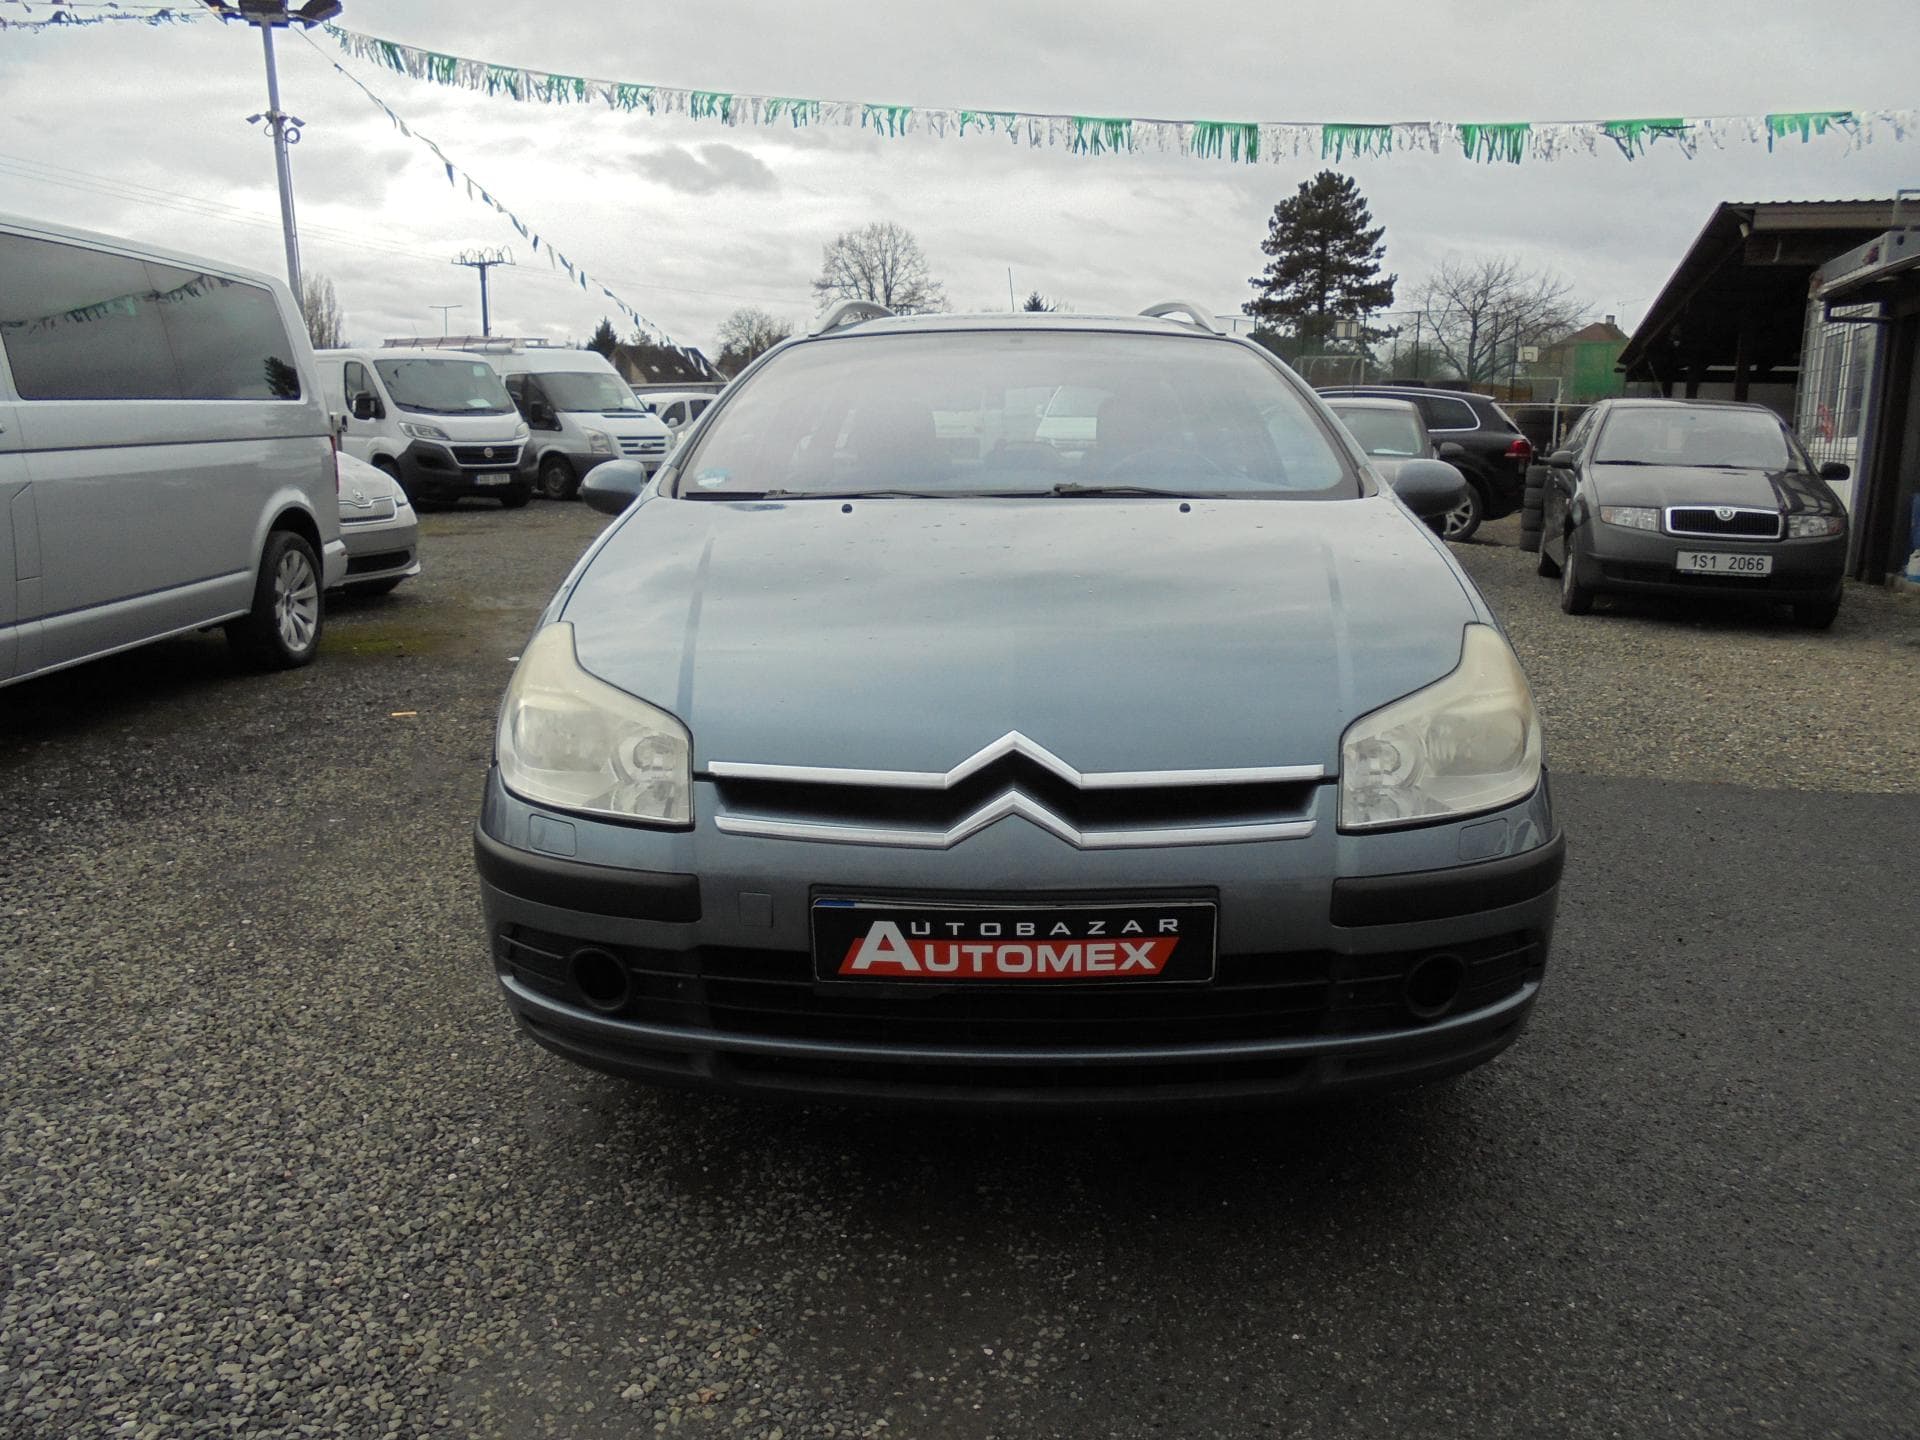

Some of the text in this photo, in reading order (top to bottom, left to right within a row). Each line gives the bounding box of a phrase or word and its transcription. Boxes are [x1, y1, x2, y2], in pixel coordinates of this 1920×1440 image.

[1690, 554, 1765, 571] 1S1 2066
[851, 920, 1157, 973] AUTOMEX
